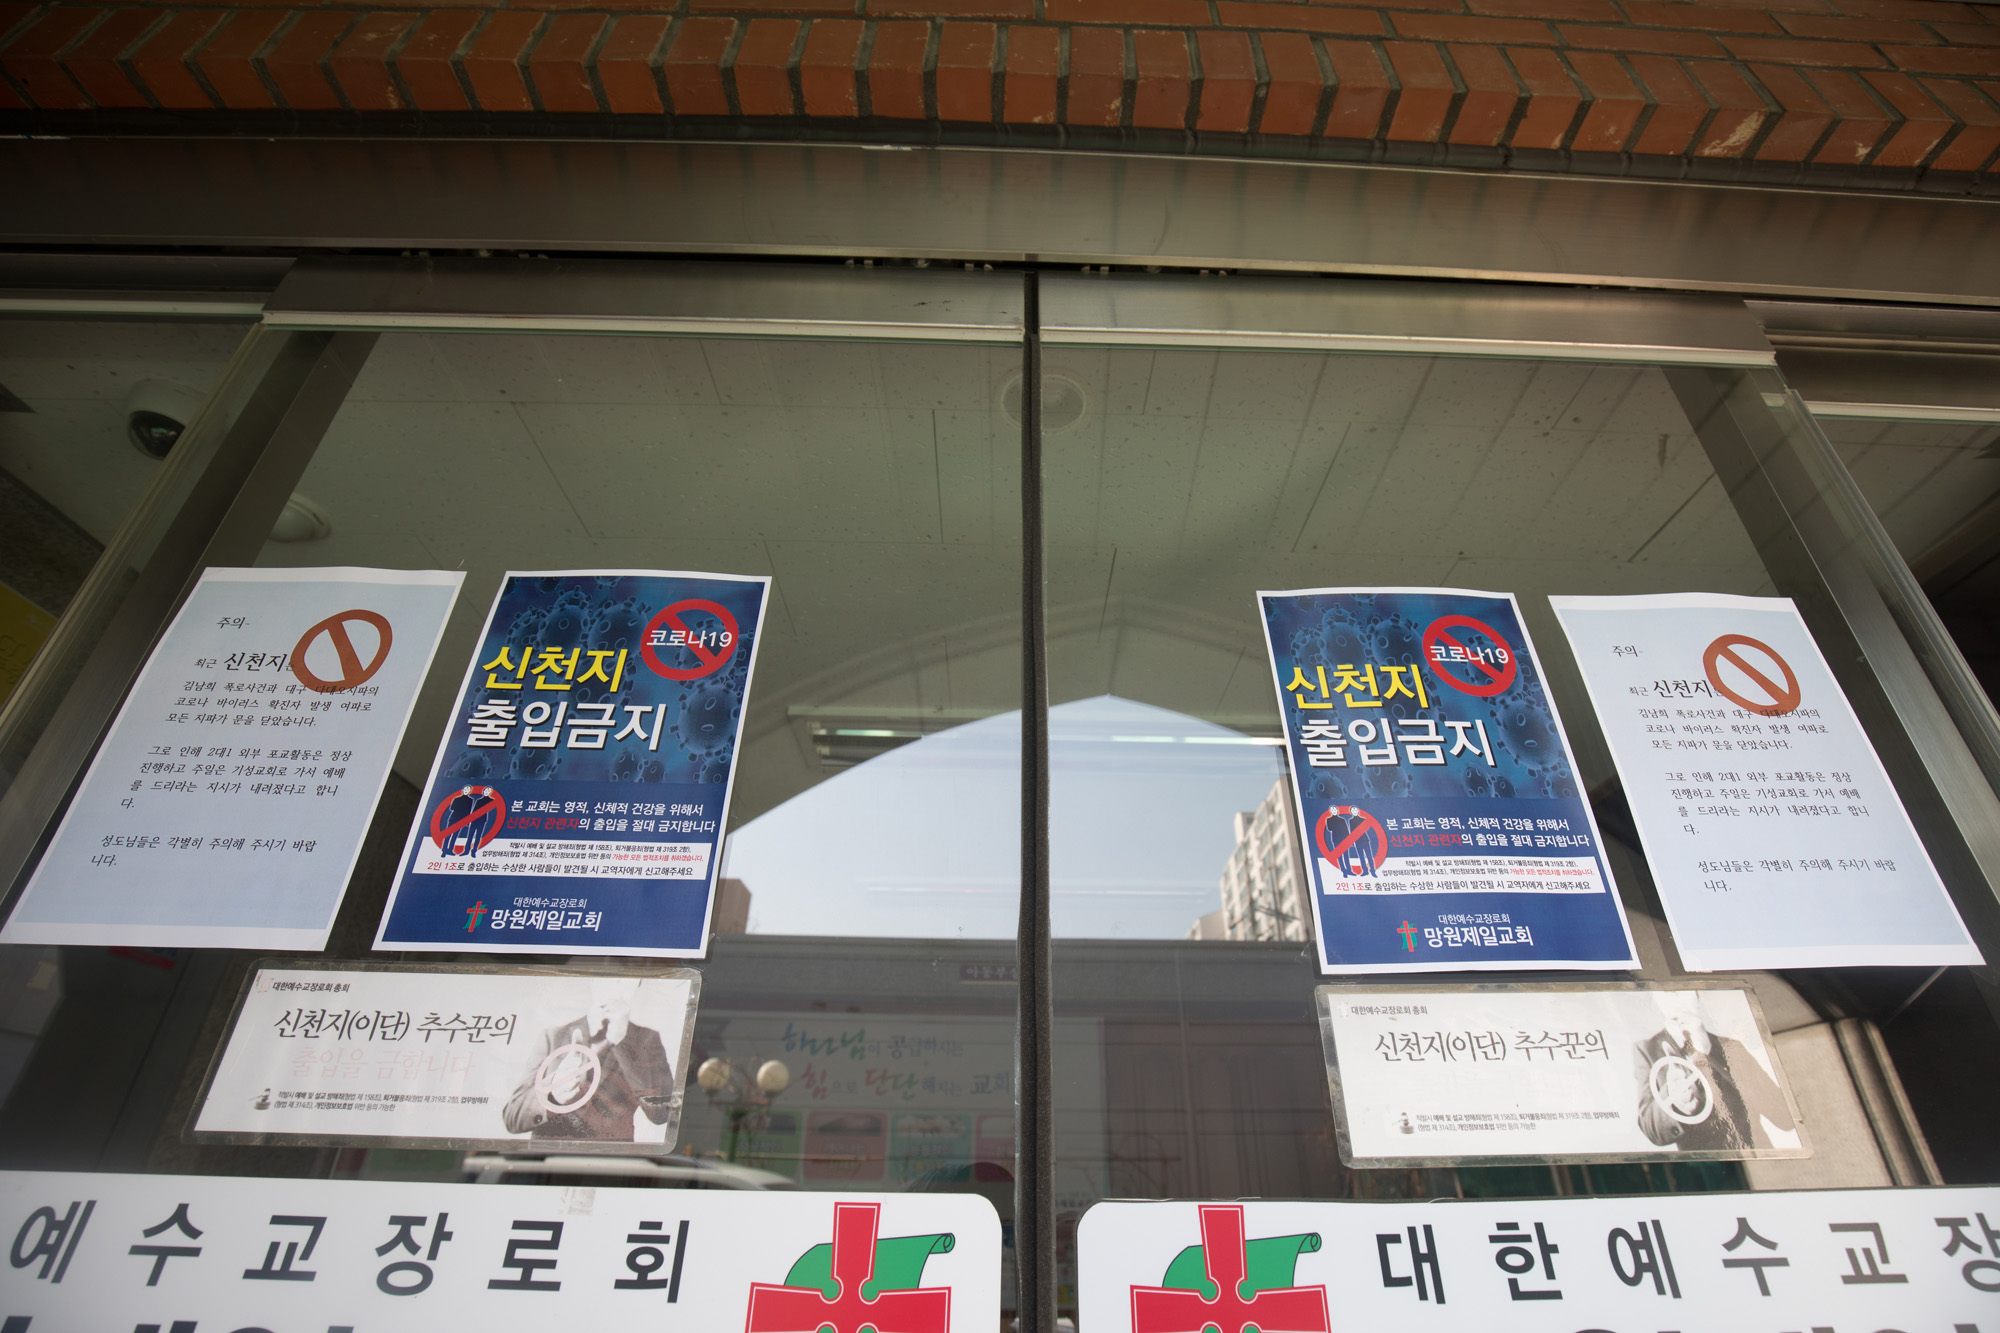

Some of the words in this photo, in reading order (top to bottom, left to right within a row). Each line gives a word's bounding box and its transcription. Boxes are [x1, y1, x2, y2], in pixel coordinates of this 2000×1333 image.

[646, 629, 733, 648] 코로나19
[194, 657, 218, 669] 최근
[1429, 645, 1510, 665] 코로나19
[482, 646, 628, 693] 신천지
[183, 680, 217, 693] 김남희
[223, 682, 278, 694] 폭로사건과
[284, 684, 308, 695] 대구
[1285, 663, 1429, 710] 신천지
[1628, 686, 1649, 697] 최근
[173, 696, 209, 708] 코로나
[216, 697, 259, 710] 바이러스
[267, 699, 302, 711] 확진자
[310, 700, 333, 712] 발생
[340, 701, 372, 712] 여파로
[193, 713, 229, 725] 지파가
[232, 714, 255, 726] 문을
[260, 715, 317, 728] 닫았습니다.
[1637, 708, 1670, 719] 김남희
[1675, 708, 1727, 720] 폭로사건과
[1731, 708, 1754, 720] 대구
[466, 699, 667, 750] 출입금지
[1645, 723, 1676, 735] 코로나
[1681, 724, 1725, 735] 바이러스
[1730, 724, 1763, 735] 확진자
[1767, 723, 1791, 735] 발생
[1797, 723, 1829, 735] 여파로
[1299, 717, 1495, 767] 출입금지
[1676, 739, 1708, 751] 지파가
[1712, 739, 1733, 751] 문을
[1736, 739, 1793, 751] 닫았습니다.
[147, 745, 172, 756] 그로
[179, 745, 203, 758] 인해
[206, 746, 233, 759] 2대1
[237, 747, 261, 760] 외부
[266, 749, 323, 761] 포교활동은
[329, 750, 353, 763] 정상
[139, 761, 187, 775] 진행하고
[191, 763, 226, 776] 주일은
[231, 764, 288, 777] 기성교회로
[293, 766, 318, 779] 가서
[322, 767, 346, 779] 예배
[1664, 772, 1687, 782] 그로
[1691, 771, 1715, 783] 인해
[1717, 771, 1742, 783] 2대1
[1746, 771, 1769, 783] 외부
[1774, 770, 1827, 783] 포교활동은
[1830, 771, 1852, 784] 정상
[130, 779, 143, 792] 를
[149, 780, 198, 793] 드리라는
[206, 781, 242, 794] 지시가
[250, 782, 307, 796] 내려졌다고
[316, 784, 339, 797] 합니
[1670, 787, 1716, 800] 진행하고
[1719, 787, 1751, 800] 주일은
[1755, 787, 1810, 800] 기성교회로
[1812, 787, 1836, 800] 가서
[1838, 788, 1862, 800] 예배
[120, 797, 135, 810] 다.
[510, 799, 524, 813] 본
[524, 800, 561, 813] 교회는
[564, 801, 590, 815] 영적,
[593, 801, 629, 815] 신체적
[631, 802, 667, 816] 건강을
[668, 803, 704, 817] 위해서
[1677, 805, 1689, 818] 를
[1697, 805, 1741, 817] 드리라는
[1747, 804, 1781, 817] 지시가
[1786, 804, 1842, 817] 내려졌다고
[1847, 805, 1870, 817] 합니
[506, 816, 542, 830] 신천지
[543, 817, 592, 831] 관련자의
[593, 817, 629, 832] 출입을
[631, 819, 656, 833] 절대
[657, 819, 716, 833] 금지합니다
[1386, 818, 1399, 831] 본
[1401, 817, 1436, 830] 교회는
[1437, 816, 1466, 830] 영적,
[1467, 817, 1501, 830] 신체적
[1501, 817, 1535, 831] 건강을
[1536, 818, 1570, 832] 위해서
[1683, 823, 1700, 836] 다.
[101, 834, 161, 849] 성도님들은
[167, 836, 204, 850] 각별히
[208, 837, 246, 851] 주의해
[249, 838, 287, 852] 주시기
[292, 839, 318, 853] 바랍
[1389, 833, 1426, 848] 신천지
[1427, 833, 1474, 847] 관련자의
[1475, 832, 1509, 847] 출입을
[1509, 834, 1534, 848] 절대
[1534, 833, 1590, 848] 금지합니다
[90, 853, 117, 868] 니다.
[1698, 860, 1754, 874] 성도님들은
[1757, 859, 1794, 872] 각별히
[1798, 858, 1834, 872] 주의해
[1837, 858, 1871, 872] 주시기
[1873, 859, 1897, 872] 바랍
[426, 861, 443, 872] 2인
[467, 862, 500, 872] 출입하는
[501, 862, 527, 873] 수상한
[527, 863, 562, 874] 사람들이
[589, 865, 600, 875] 시
[600, 865, 644, 876] 교역자에게
[644, 866, 694, 877] 신고해주세요
[1335, 882, 1350, 892] 2인
[1374, 881, 1408, 892] 출입하는
[1409, 880, 1434, 891] 수상한
[1436, 880, 1469, 890] 사람들이
[1496, 880, 1505, 890] 시
[1506, 880, 1545, 890] 교역자에게
[1545, 880, 1592, 891] 신고해주세요
[1703, 879, 1733, 893] 니다.
[512, 896, 588, 909] 대한예수교장로회
[490, 906, 603, 932] 망원제일교회
[1437, 913, 1512, 925] 대한예수교장로회
[1423, 925, 1535, 949] 망원제일교회
[272, 981, 334, 993] 대한예수교장로회
[1350, 1006, 1412, 1016] 대한예수교장로회
[273, 1007, 411, 1042] 신천지(이단)
[416, 1011, 518, 1046] 추수꾼의
[1374, 1030, 1507, 1063] 신천지(이단)
[1514, 1029, 1609, 1062] 추수꾼의
[970, 1072, 1010, 1096] 교회
